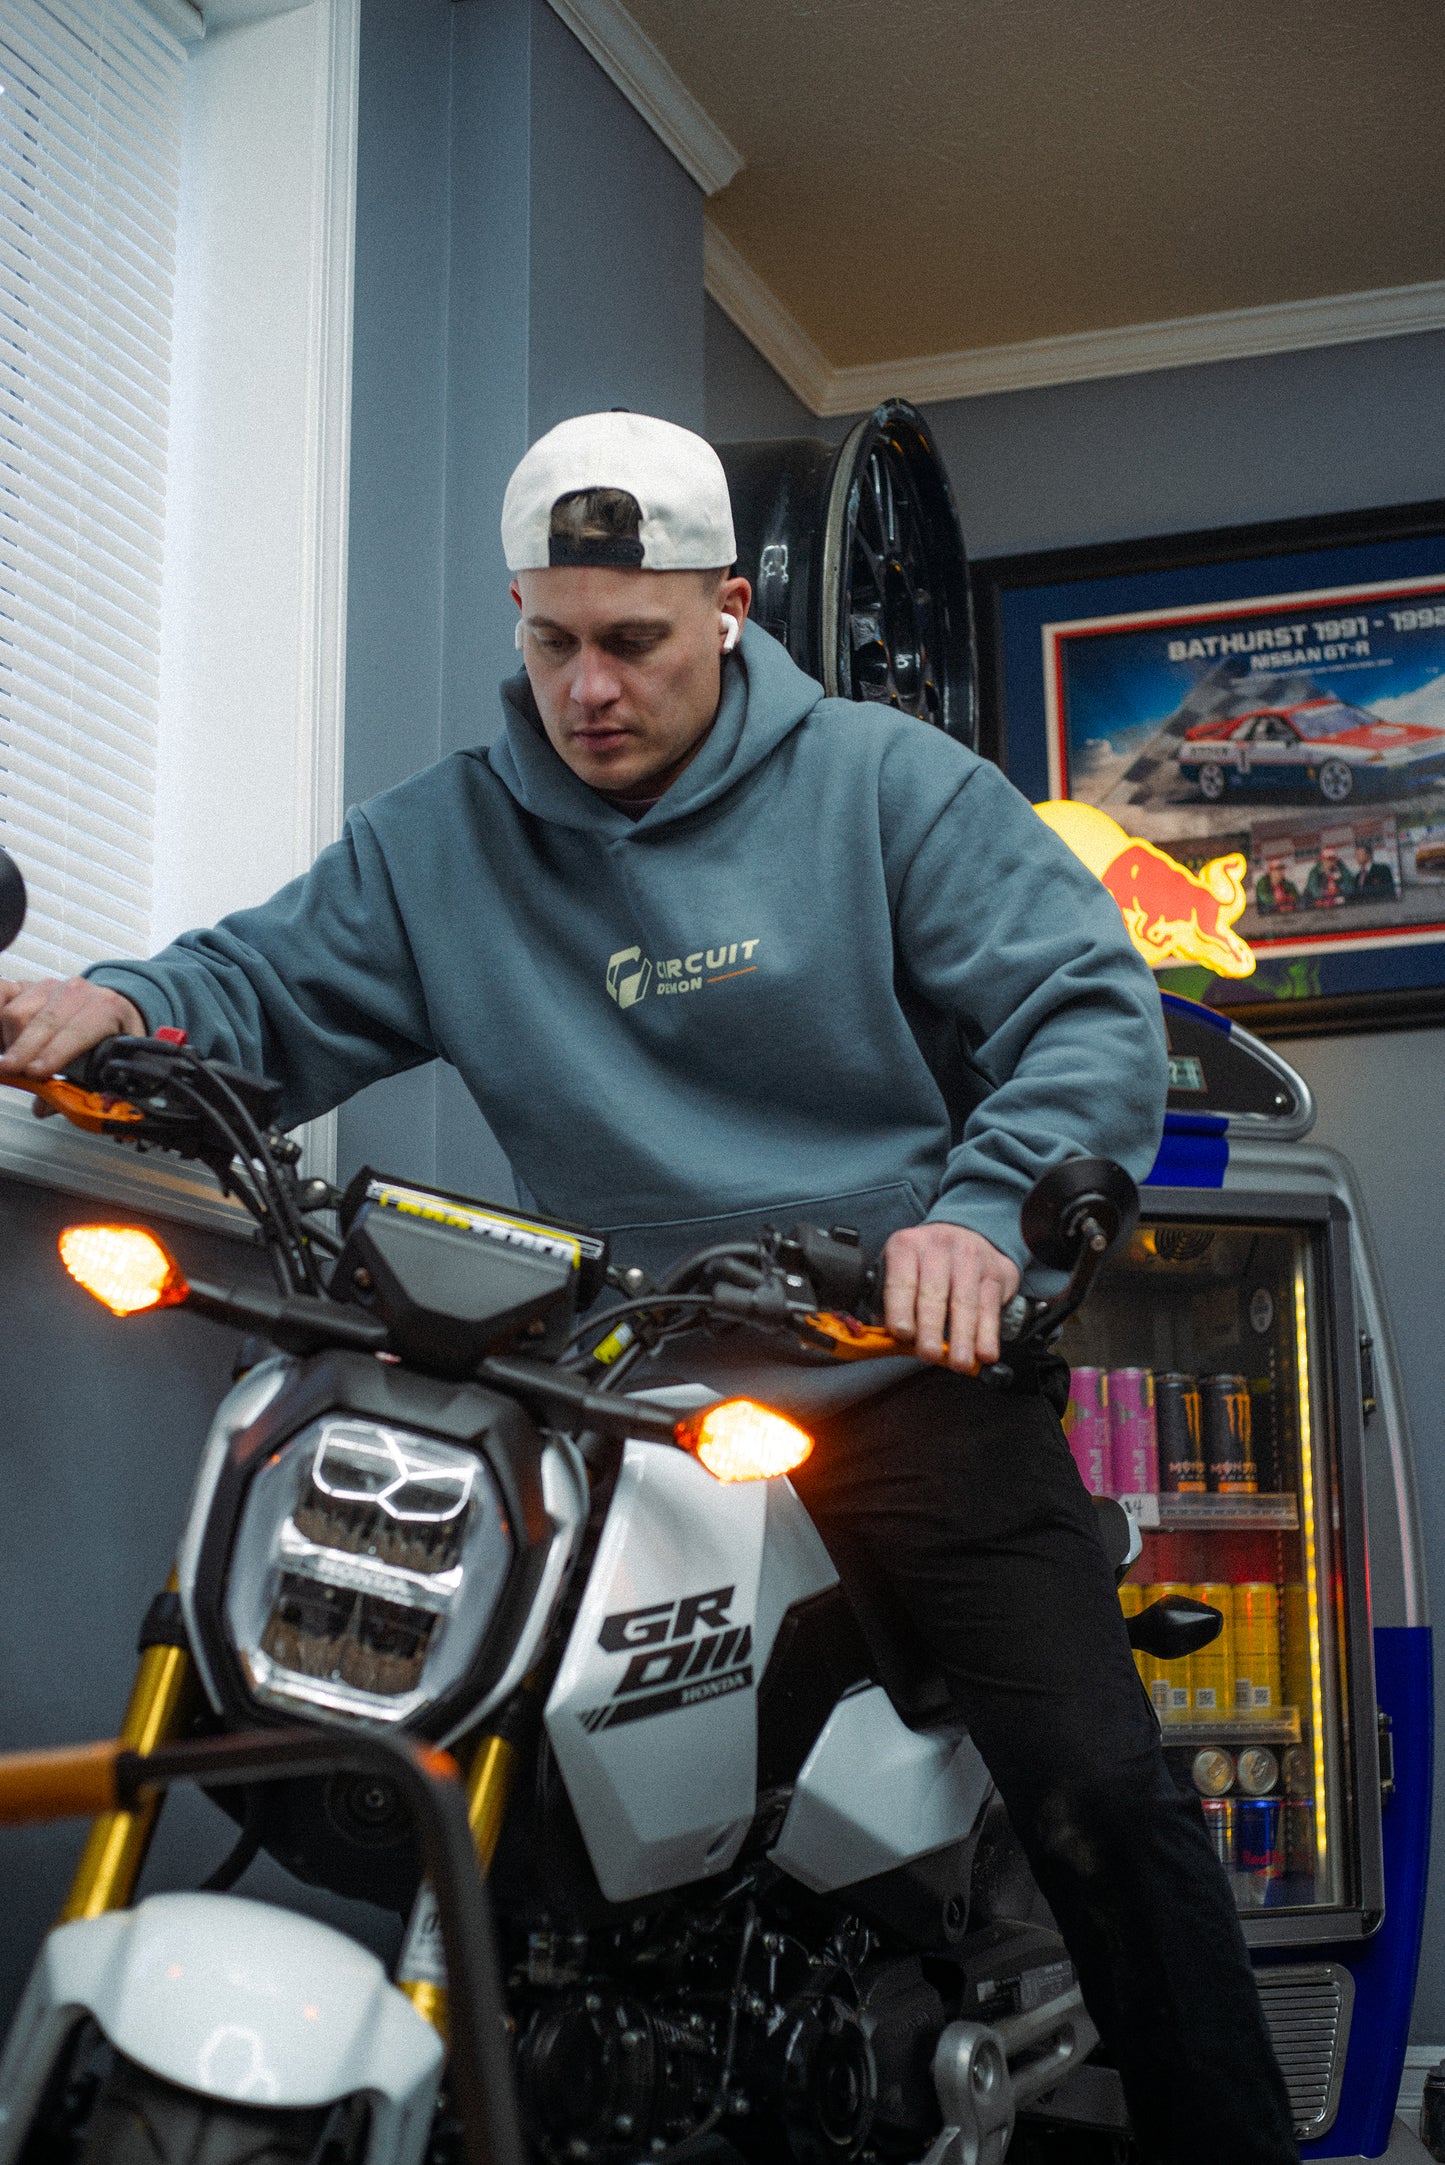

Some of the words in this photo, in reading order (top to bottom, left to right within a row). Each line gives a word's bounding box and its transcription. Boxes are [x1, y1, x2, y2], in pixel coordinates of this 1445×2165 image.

[1168, 624, 1309, 662] BATHURST
[1312, 616, 1369, 642] 1991
[1250, 646, 1322, 671] NISSAN
[1323, 640, 1371, 661] GT-R
[656, 938, 760, 979] CIRCUIT
[656, 977, 703, 995] DEMON
[681, 1672, 746, 1703] HONDA
